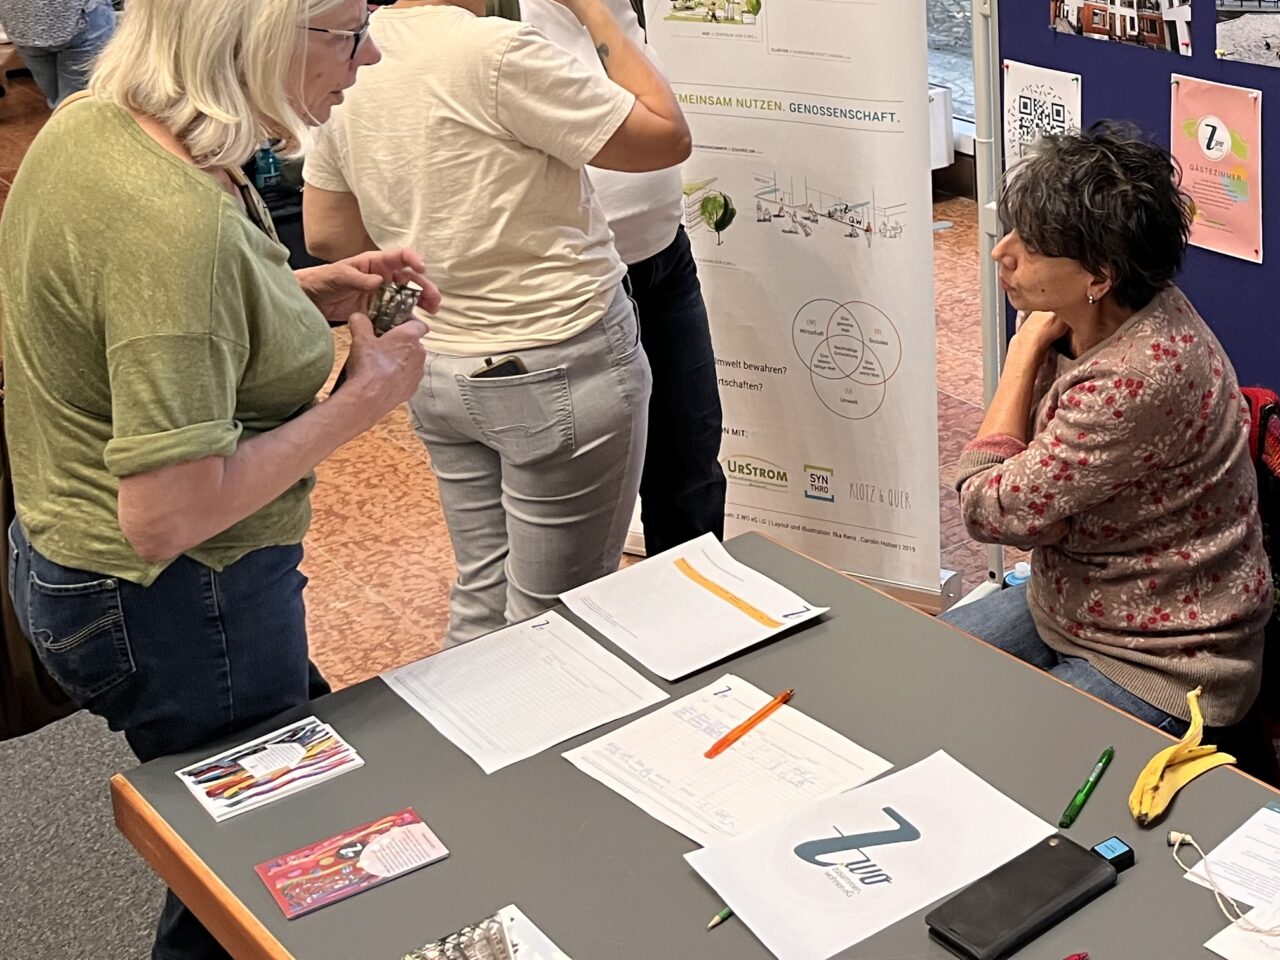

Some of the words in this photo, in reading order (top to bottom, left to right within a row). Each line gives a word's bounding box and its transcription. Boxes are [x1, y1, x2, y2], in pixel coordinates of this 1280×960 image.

[674, 93, 732, 107] MEINSAM
[736, 98, 786, 112] NUTZEN.
[789, 102, 901, 124] GENOSSENSCHAFT.
[1189, 163, 1242, 182] GÄSTEZIMMER
[715, 357, 742, 369] mwelt
[743, 360, 788, 375] bewahren?
[718, 378, 763, 392] rtschaften?
[732, 428, 749, 438] MIT:
[810, 474, 828, 485] SYN
[810, 484, 829, 494] THRO
[850, 482, 876, 503] KLOTZ
[888, 491, 912, 510] QUER
[902, 544, 916, 553] 2019
